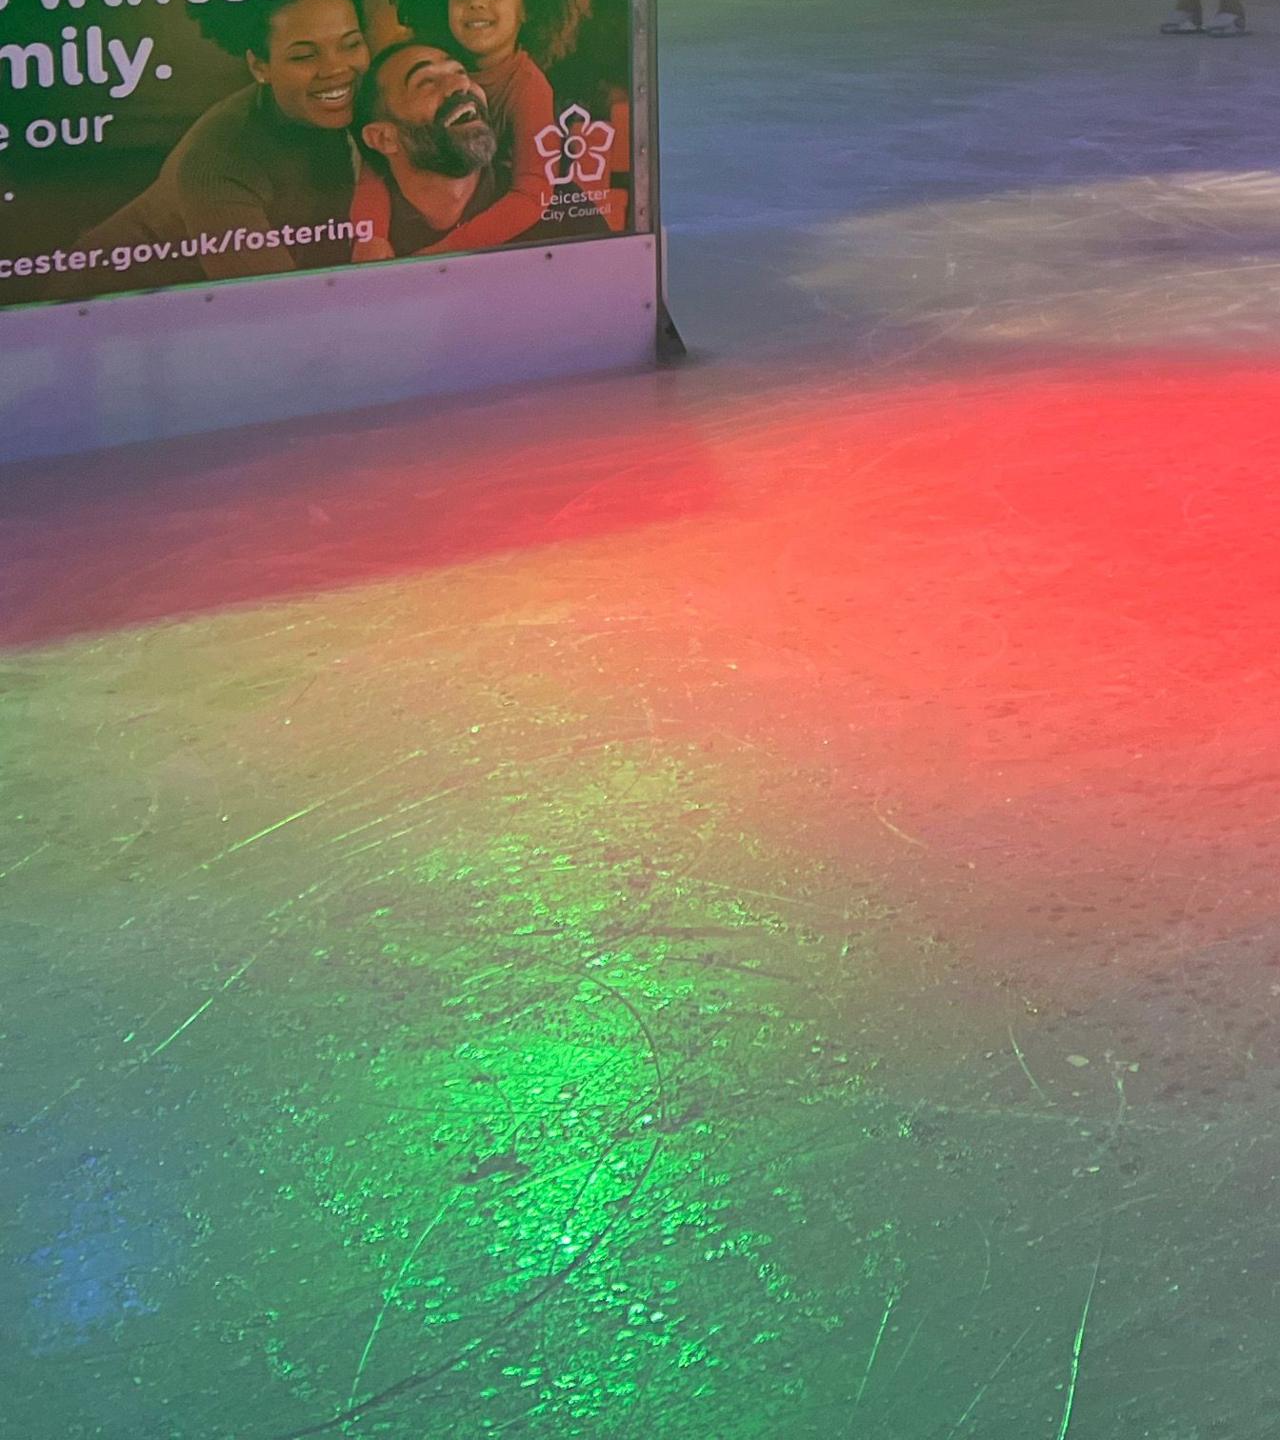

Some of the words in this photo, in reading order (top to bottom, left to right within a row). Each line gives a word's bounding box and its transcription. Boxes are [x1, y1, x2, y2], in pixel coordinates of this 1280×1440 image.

[25, 114, 114, 148] our
[541, 189, 611, 207] Leicester
[541, 209, 565, 222] City
[568, 203, 611, 218] Council
